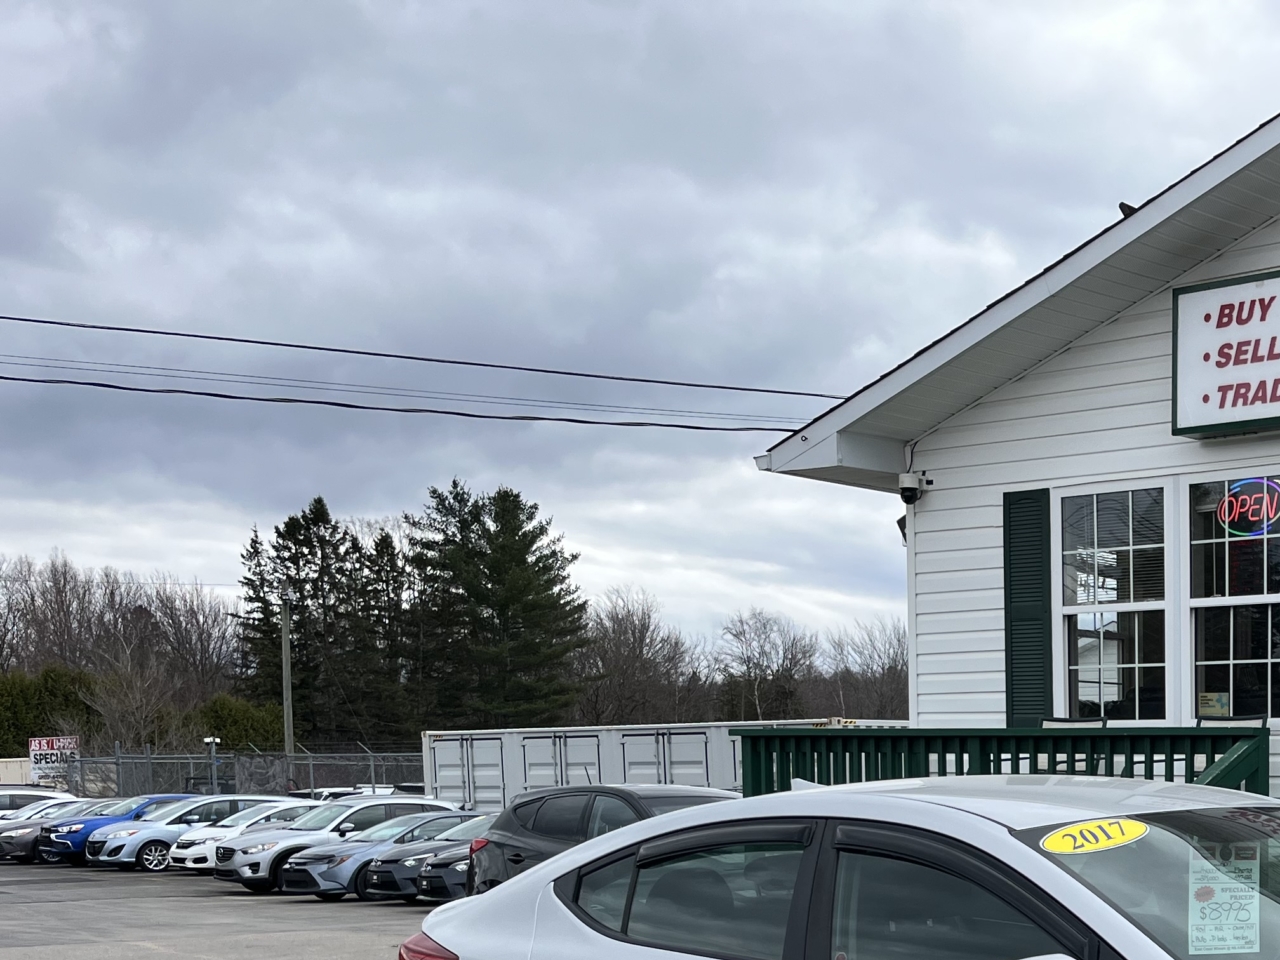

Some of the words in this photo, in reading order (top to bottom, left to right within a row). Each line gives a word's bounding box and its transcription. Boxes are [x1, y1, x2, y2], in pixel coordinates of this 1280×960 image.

[1216, 295, 1277, 330] BUY
[1220, 491, 1279, 523] OPEN
[30, 739, 40, 750] AS
[1061, 821, 1128, 851] 2017
